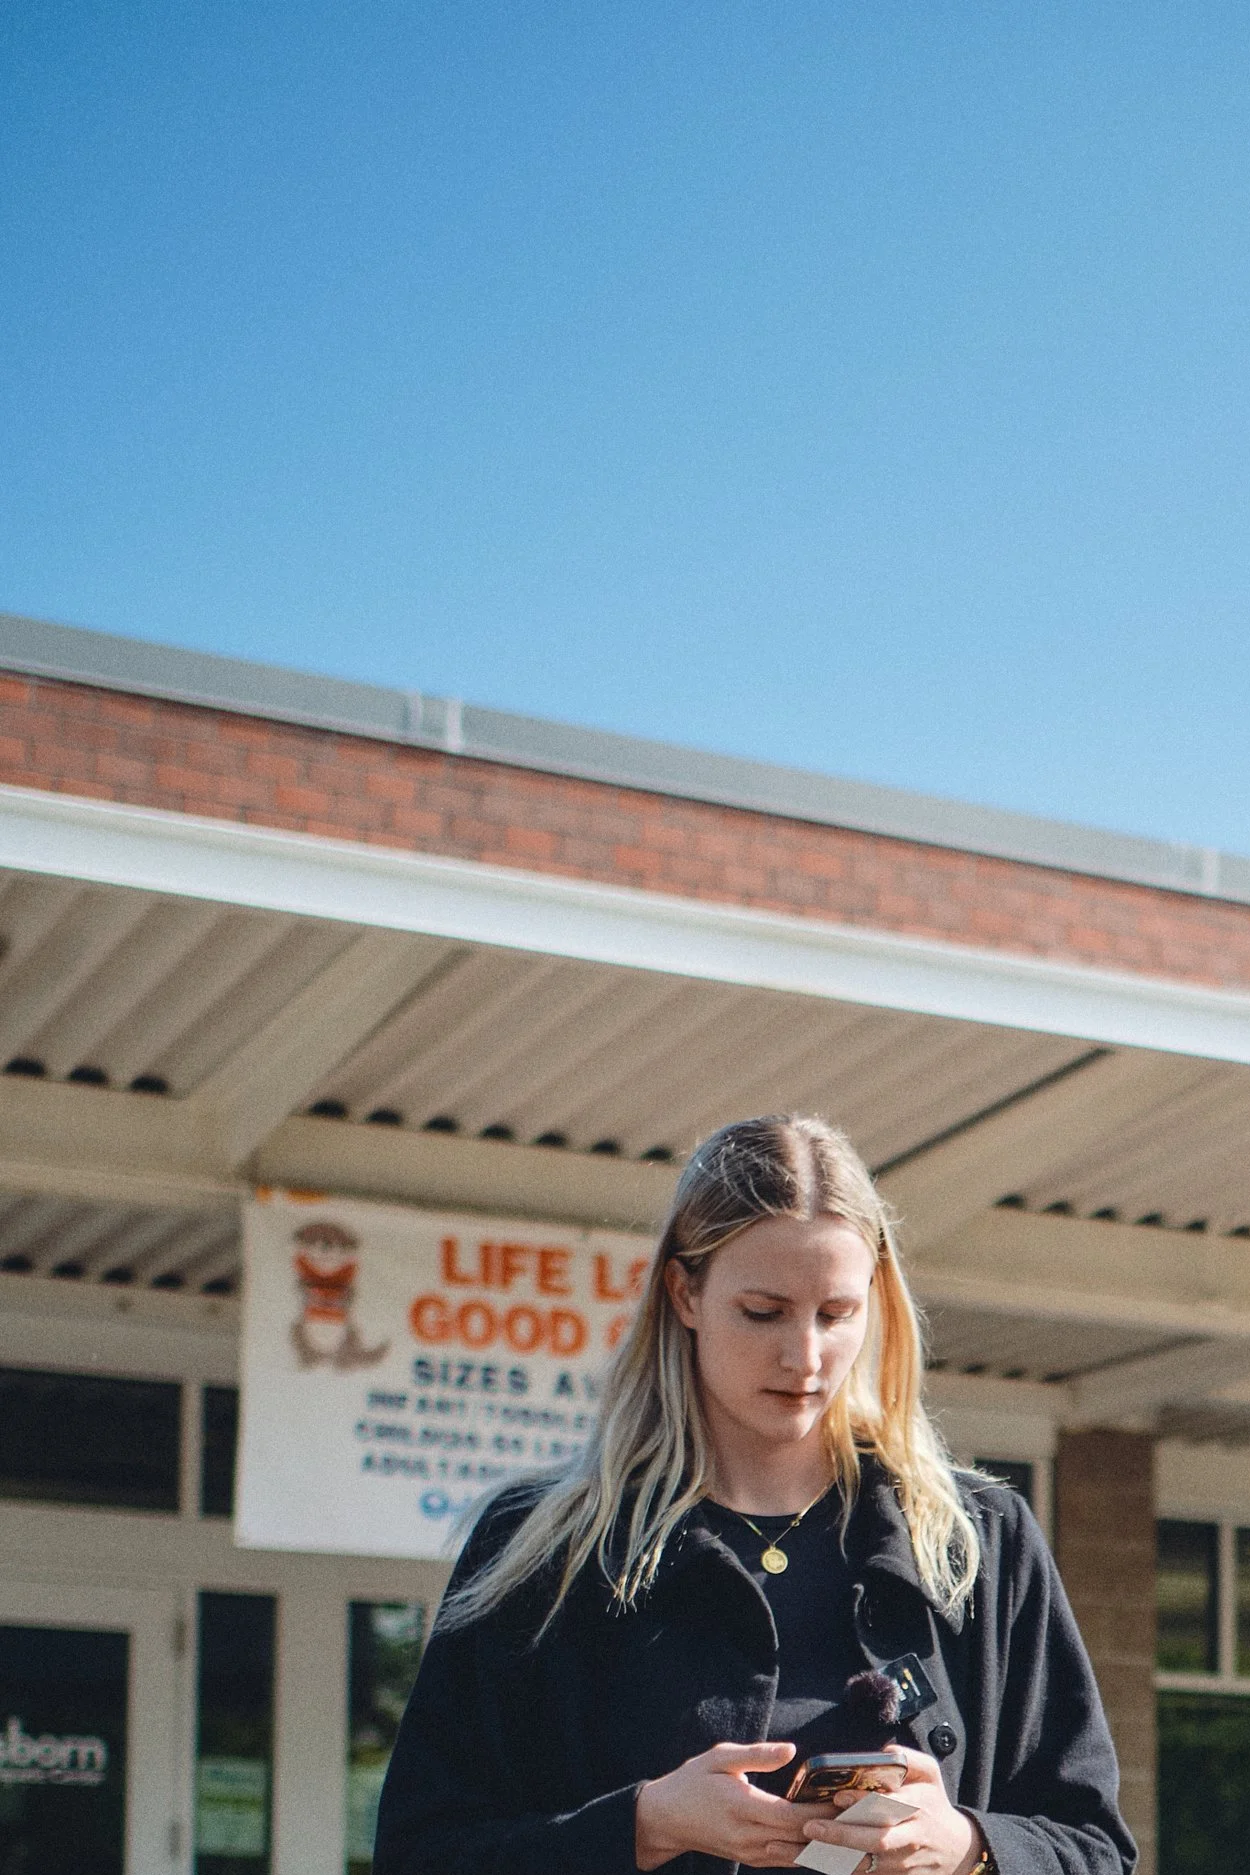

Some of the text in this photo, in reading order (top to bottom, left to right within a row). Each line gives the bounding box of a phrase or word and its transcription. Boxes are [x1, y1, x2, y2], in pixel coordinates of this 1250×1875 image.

[438, 1234, 573, 1298] LIFE
[409, 1293, 590, 1358] GOOD
[411, 1357, 529, 1396] SIZES
